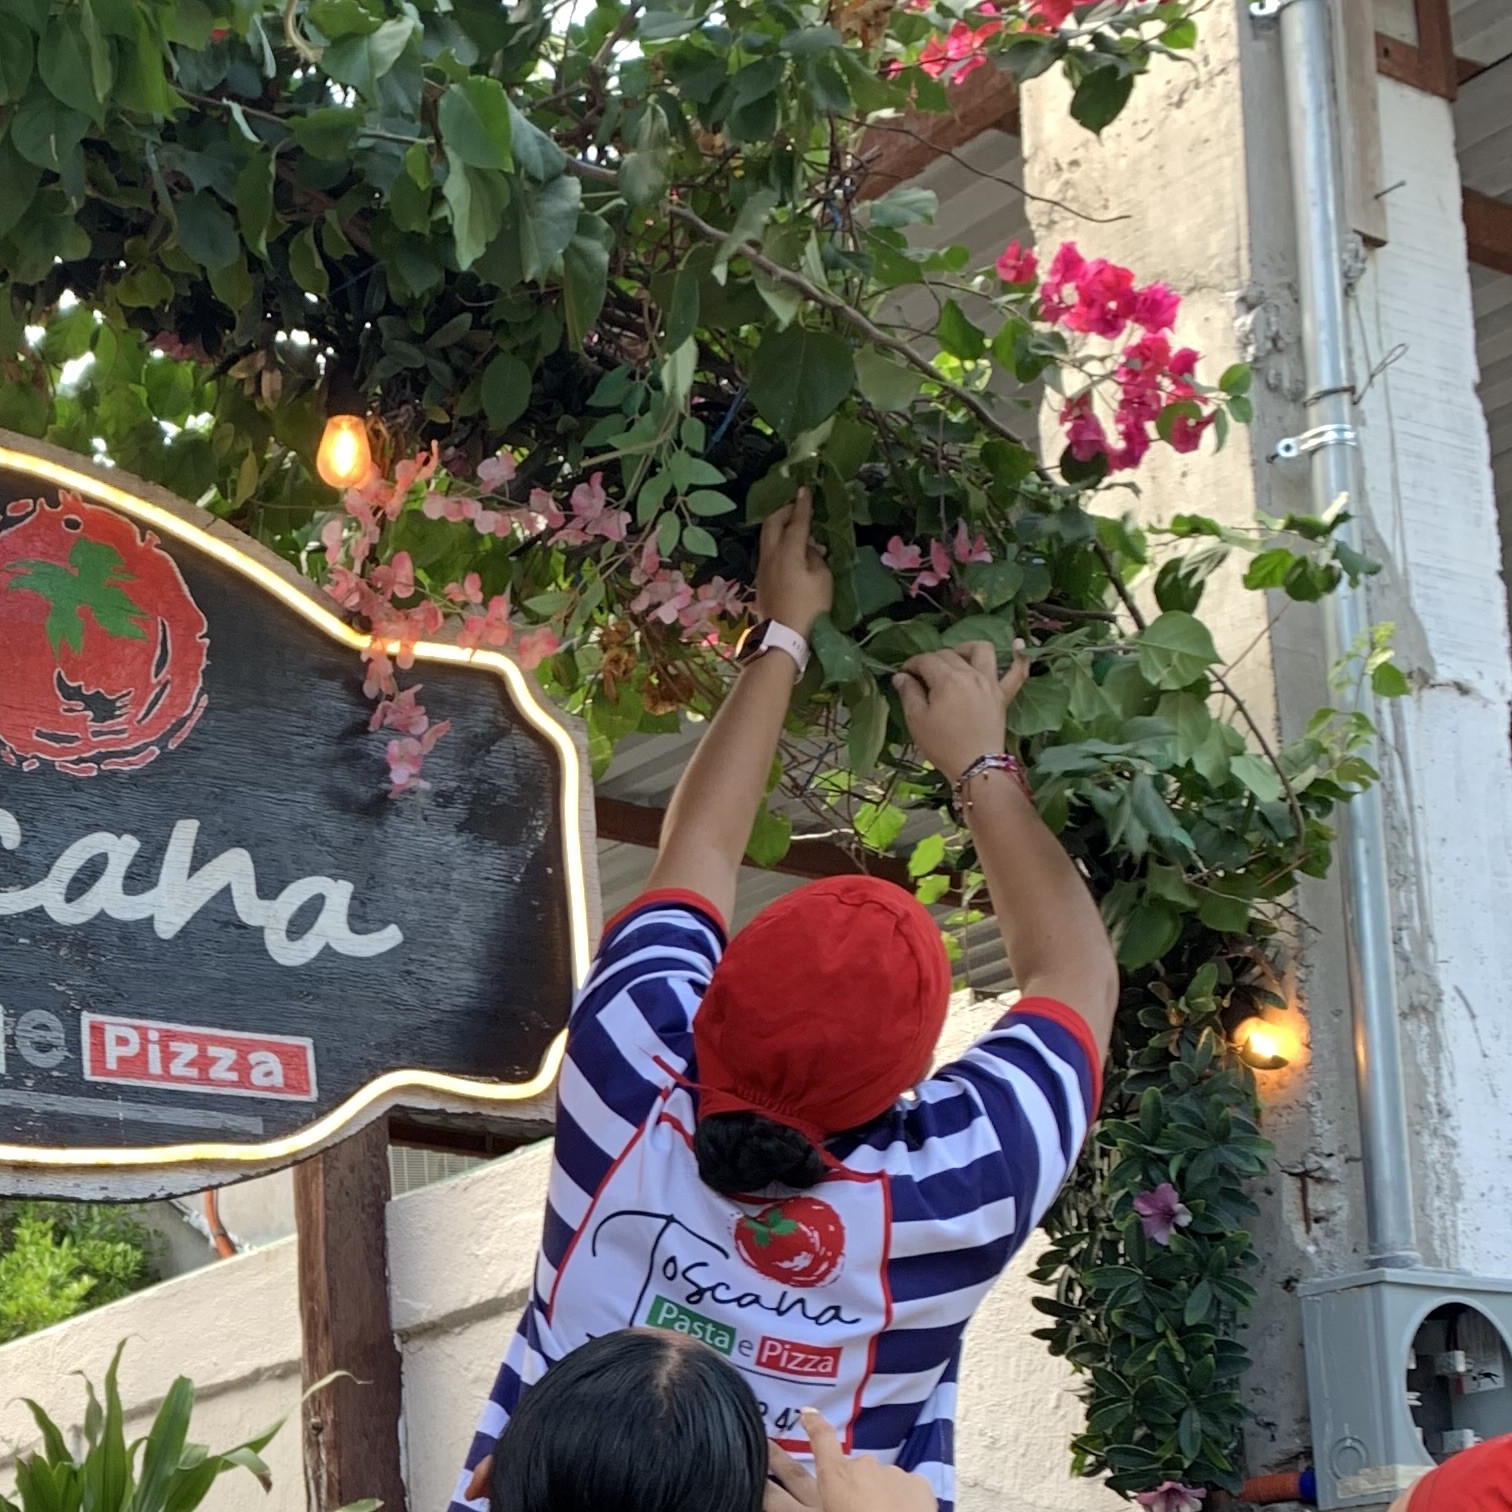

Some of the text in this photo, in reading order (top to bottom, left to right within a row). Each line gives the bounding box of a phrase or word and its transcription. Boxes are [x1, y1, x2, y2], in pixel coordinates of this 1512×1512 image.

[14, 1009, 67, 1070] e
[103, 1025, 286, 1089] Pizza
[592, 1210, 861, 1328] Toscana
[656, 1301, 834, 1374] Pasta e Pizza
